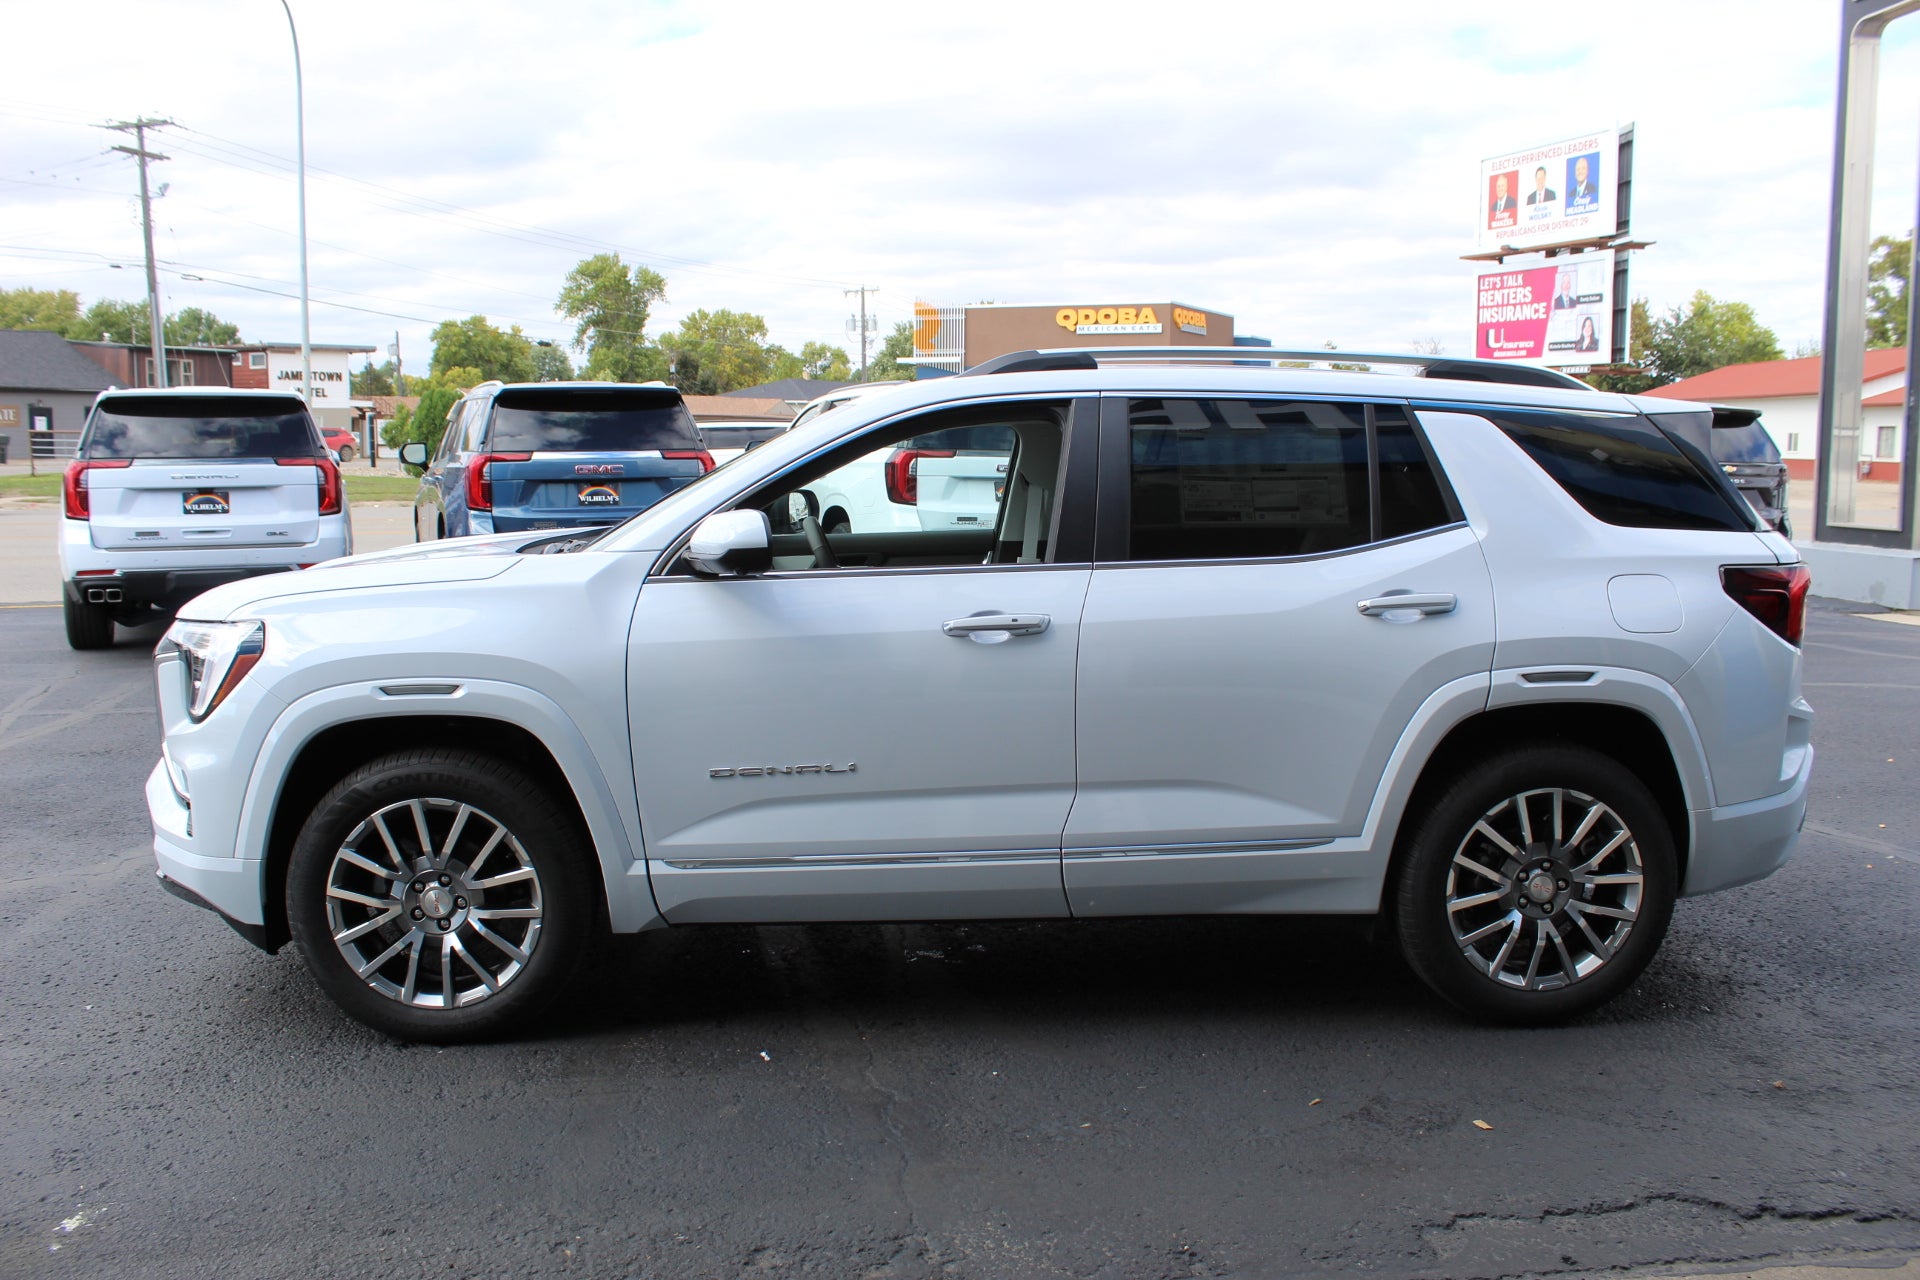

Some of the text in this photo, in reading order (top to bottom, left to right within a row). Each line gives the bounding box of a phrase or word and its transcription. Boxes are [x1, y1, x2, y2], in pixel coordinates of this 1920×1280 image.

[1491, 138, 1599, 171] ELECT EXPERIENCED LEADERS
[1496, 226, 1537, 240] REPUBLICANS
[1538, 223, 1550, 232] FOR
[1551, 218, 1579, 231] DISTRICT
[1479, 273, 1523, 290] LET'S TALK
[1479, 286, 1532, 307] RENTERS
[1056, 307, 1158, 332] QDOBA
[1174, 307, 1207, 329] QDOBA
[1479, 302, 1547, 323] INSURANCE
[277, 370, 343, 381] JAMETOWN
[575, 464, 624, 475] GMC
[183, 502, 229, 511] WILHELM'S
[578, 493, 620, 502] WILHELM'S
[709, 762, 857, 777] DENALI
